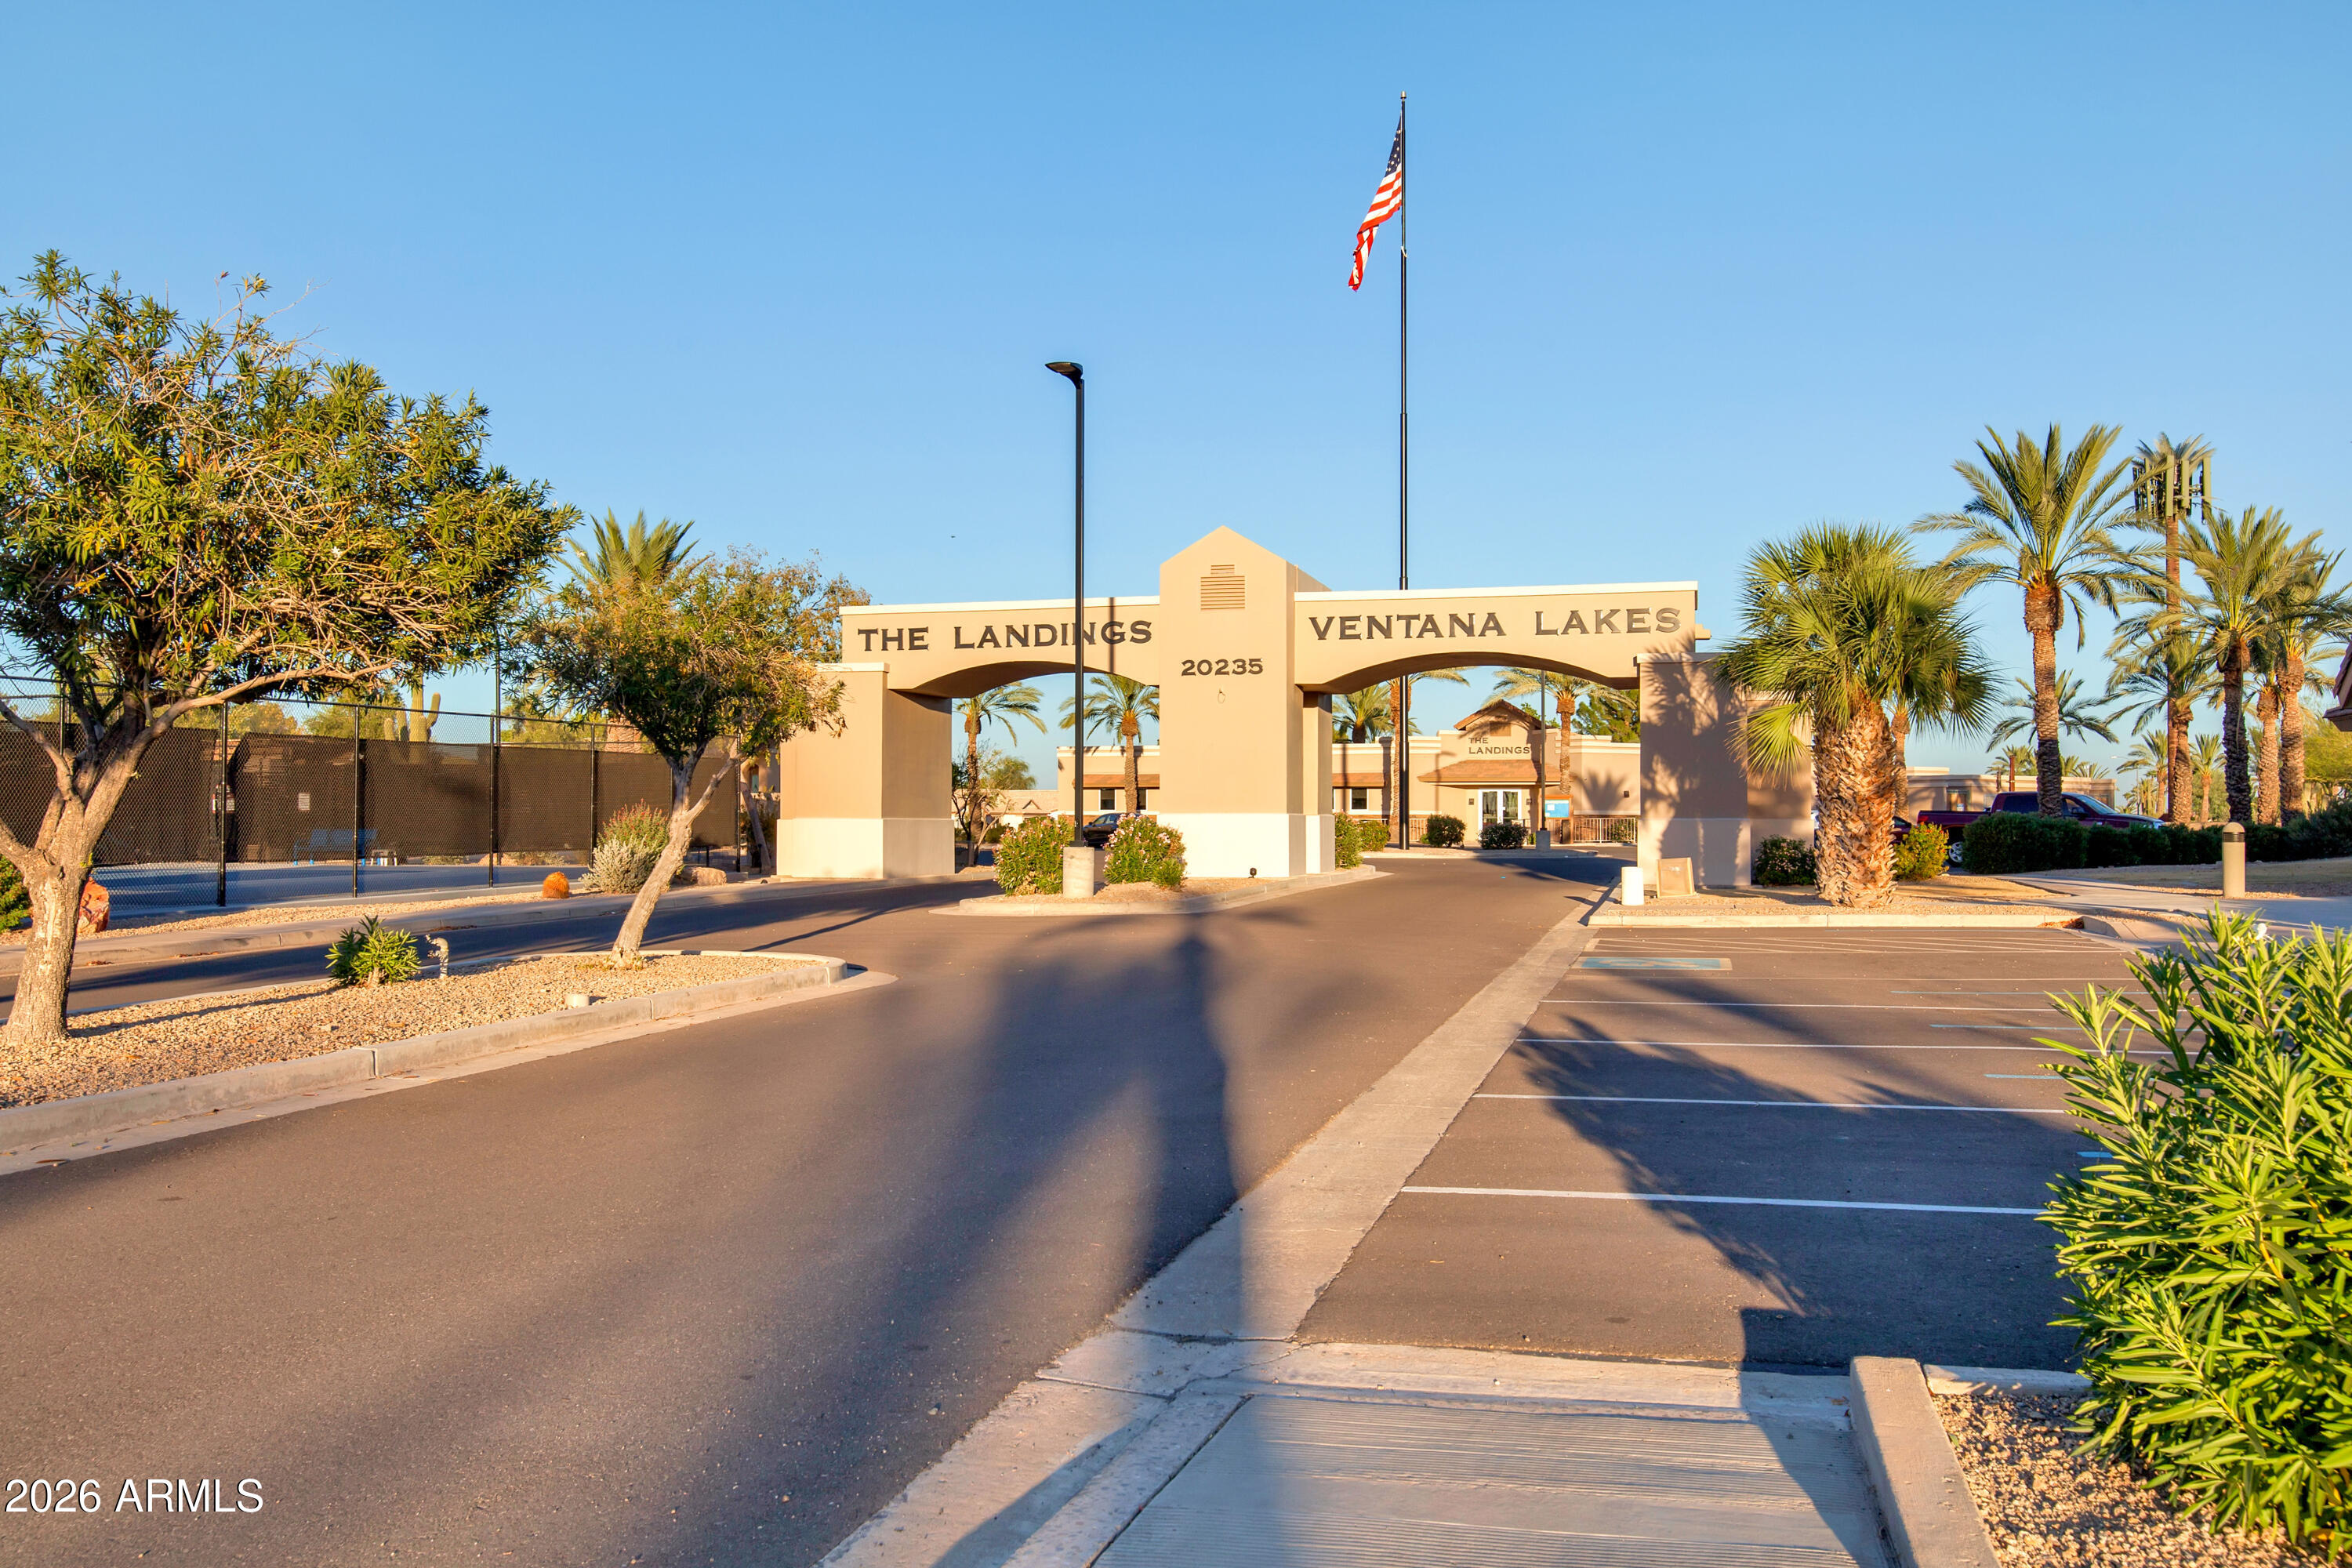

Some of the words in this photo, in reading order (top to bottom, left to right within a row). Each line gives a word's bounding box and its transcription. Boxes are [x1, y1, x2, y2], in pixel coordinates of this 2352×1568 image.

[858, 627, 929, 652] THE
[954, 620, 1152, 649] LANDINGS
[1308, 612, 1507, 641] VENTANA
[1535, 607, 1681, 636] LAKES
[1181, 658, 1264, 677] 20235
